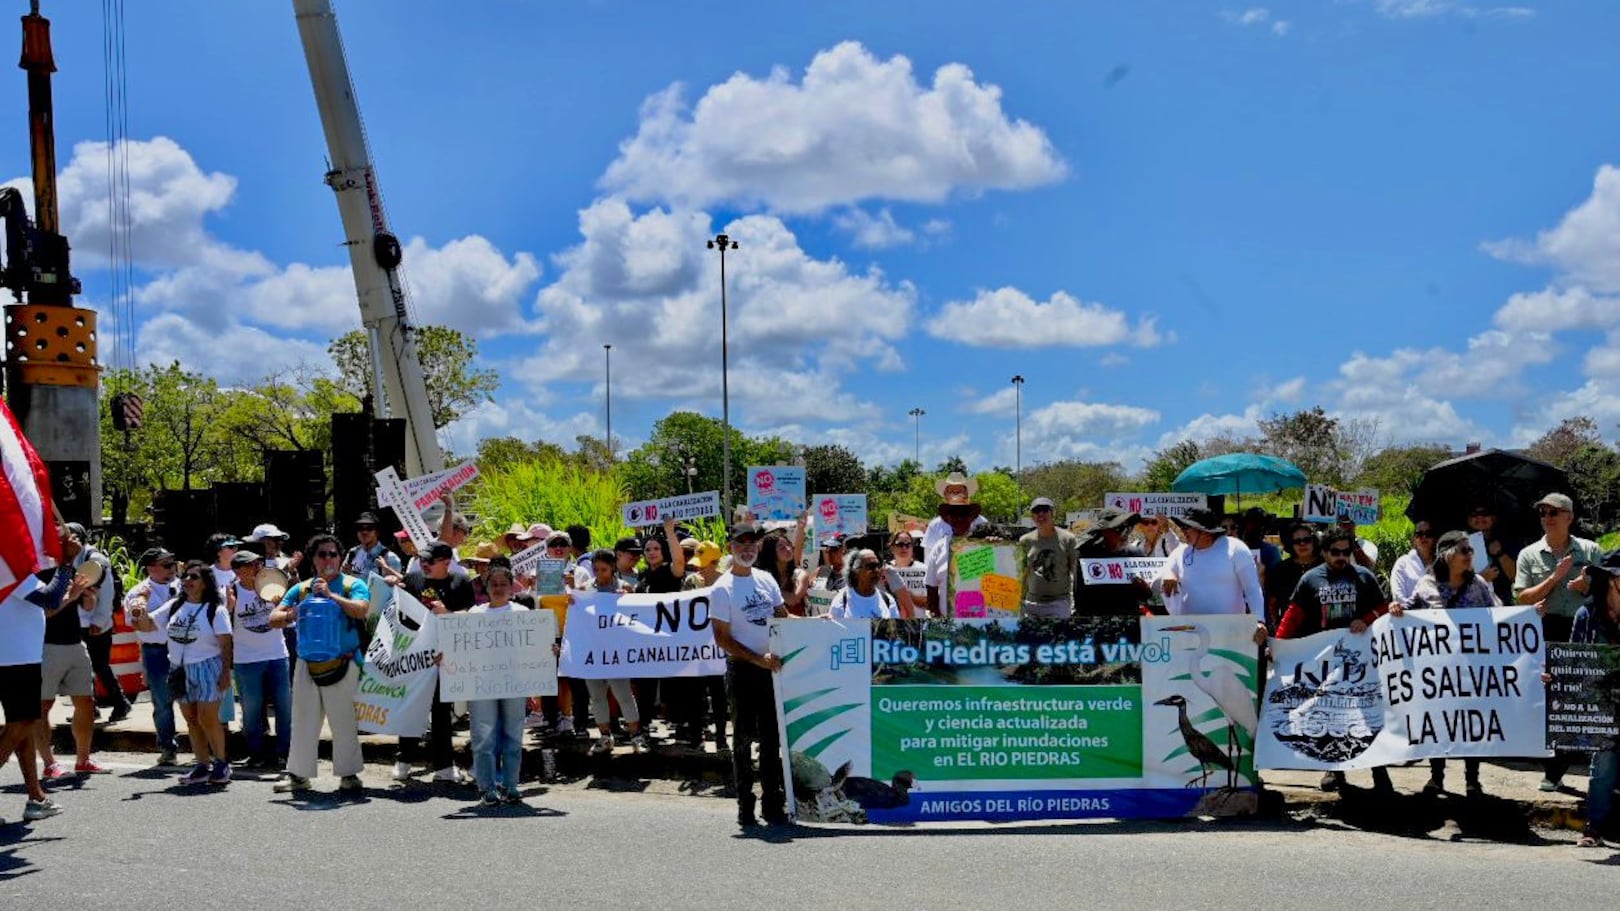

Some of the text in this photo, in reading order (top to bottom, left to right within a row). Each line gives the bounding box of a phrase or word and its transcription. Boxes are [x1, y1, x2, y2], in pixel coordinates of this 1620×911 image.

[645, 505, 658, 521] NO
[1129, 497, 1142, 513] NO
[1107, 563, 1123, 579] NO
[598, 596, 711, 633] DILE NO
[453, 628, 535, 653] PRESENTE
[1370, 622, 1539, 669] SALVAR EL RIO
[584, 650, 594, 665] A
[602, 650, 620, 665] LA
[830, 636, 1171, 671] ¡El Río Piedras está vivo!
[1550, 647, 1598, 660] ¡Quieren
[1550, 664, 1606, 677] quitarnos
[1387, 665, 1521, 706] ES SALVAR
[1550, 682, 1561, 692] el
[879, 696, 1132, 712] Queremos infraestructura verde
[1564, 703, 1599, 712] NO A LA
[925, 715, 1088, 732] y ciencia actualizada
[1406, 709, 1506, 746] LA VIDA
[1548, 724, 1565, 733] DEL
[1582, 726, 1620, 735] PIEDRAS
[900, 733, 1108, 751] para mitigar inundaciones
[933, 751, 1080, 766] en EL RIO PIEDRAS
[921, 796, 1110, 814] AMIGOS DEL RÍO PIEDRAS
